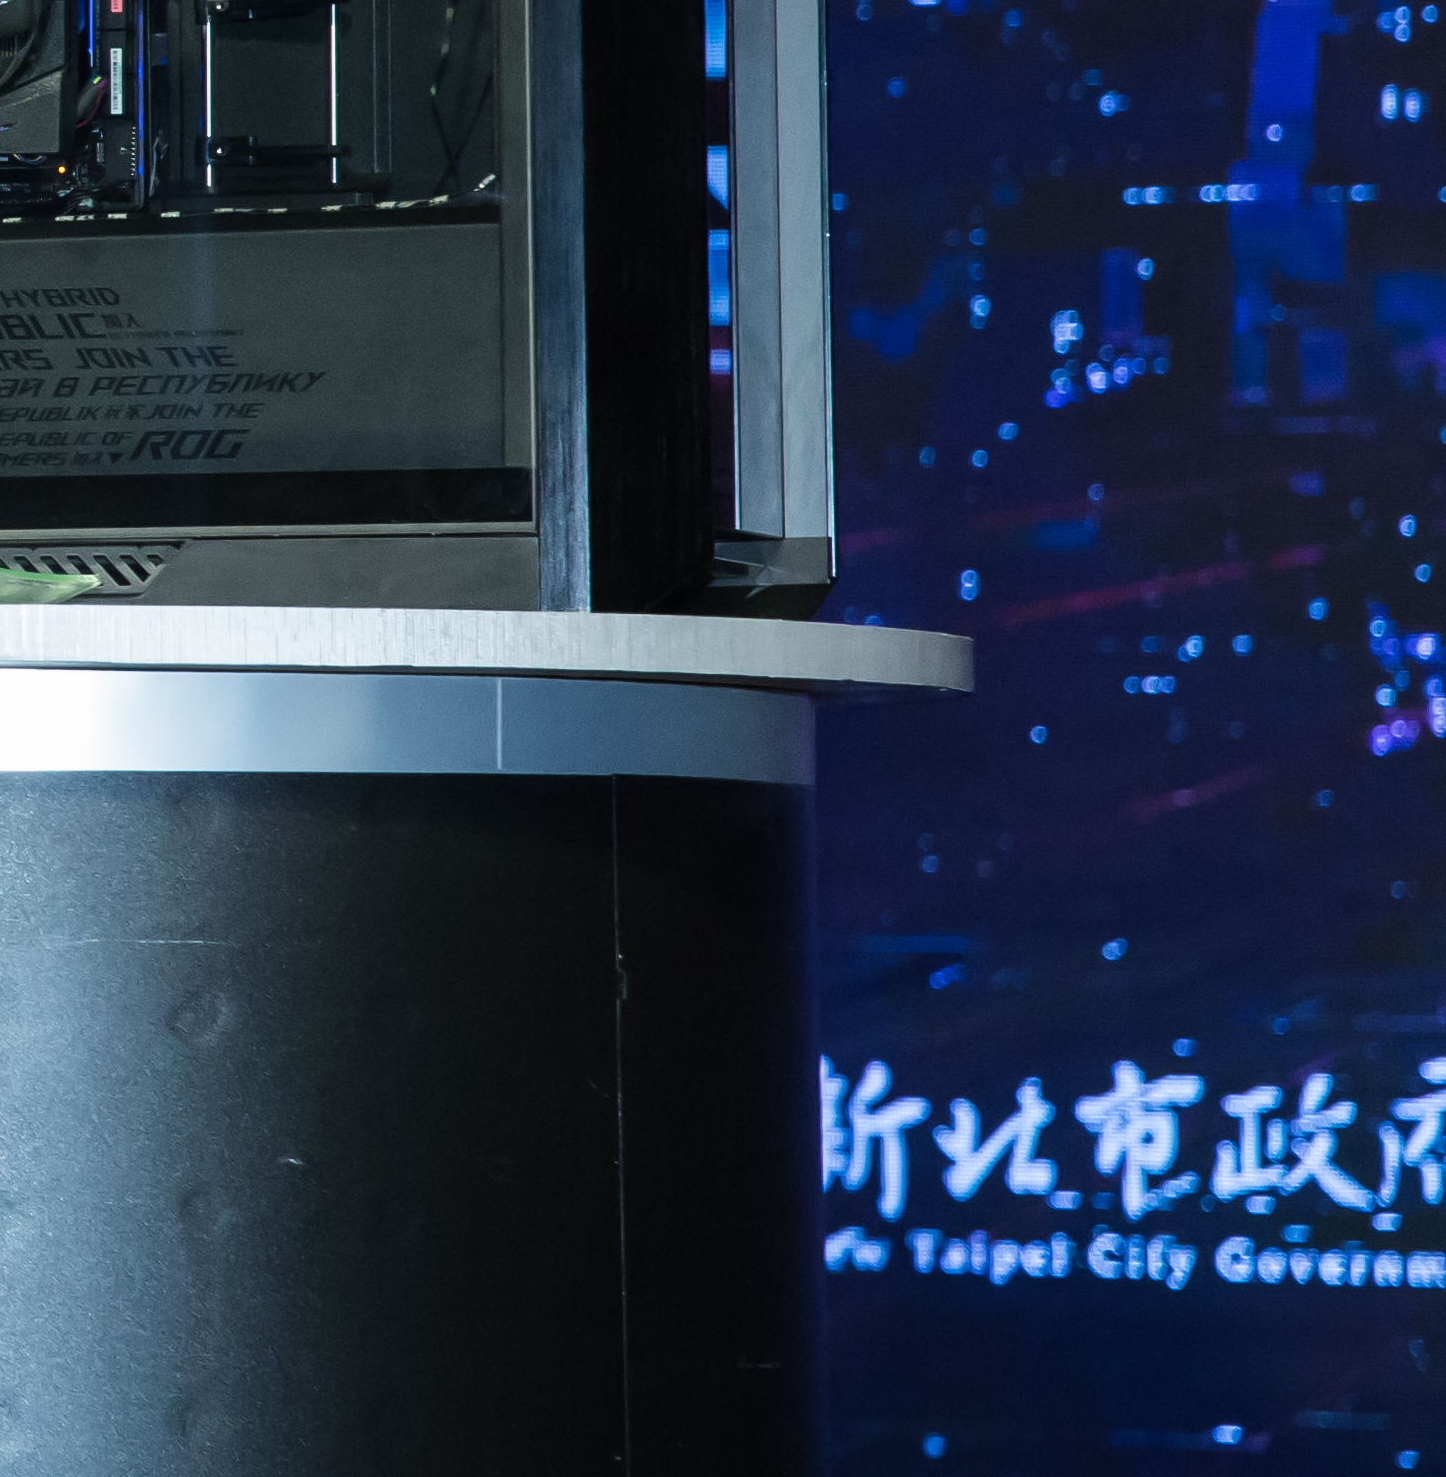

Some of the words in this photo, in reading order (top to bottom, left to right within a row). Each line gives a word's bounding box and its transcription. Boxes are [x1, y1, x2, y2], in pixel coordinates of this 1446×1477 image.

[76, 346, 152, 369] JOIN
[156, 345, 238, 367] THE
[143, 404, 203, 420] JOIN
[211, 403, 264, 419] THE
[100, 431, 133, 446] OF
[129, 429, 250, 461] ROG
[905, 1228, 1072, 1285] Taipei
[1087, 1232, 1197, 1290] City
